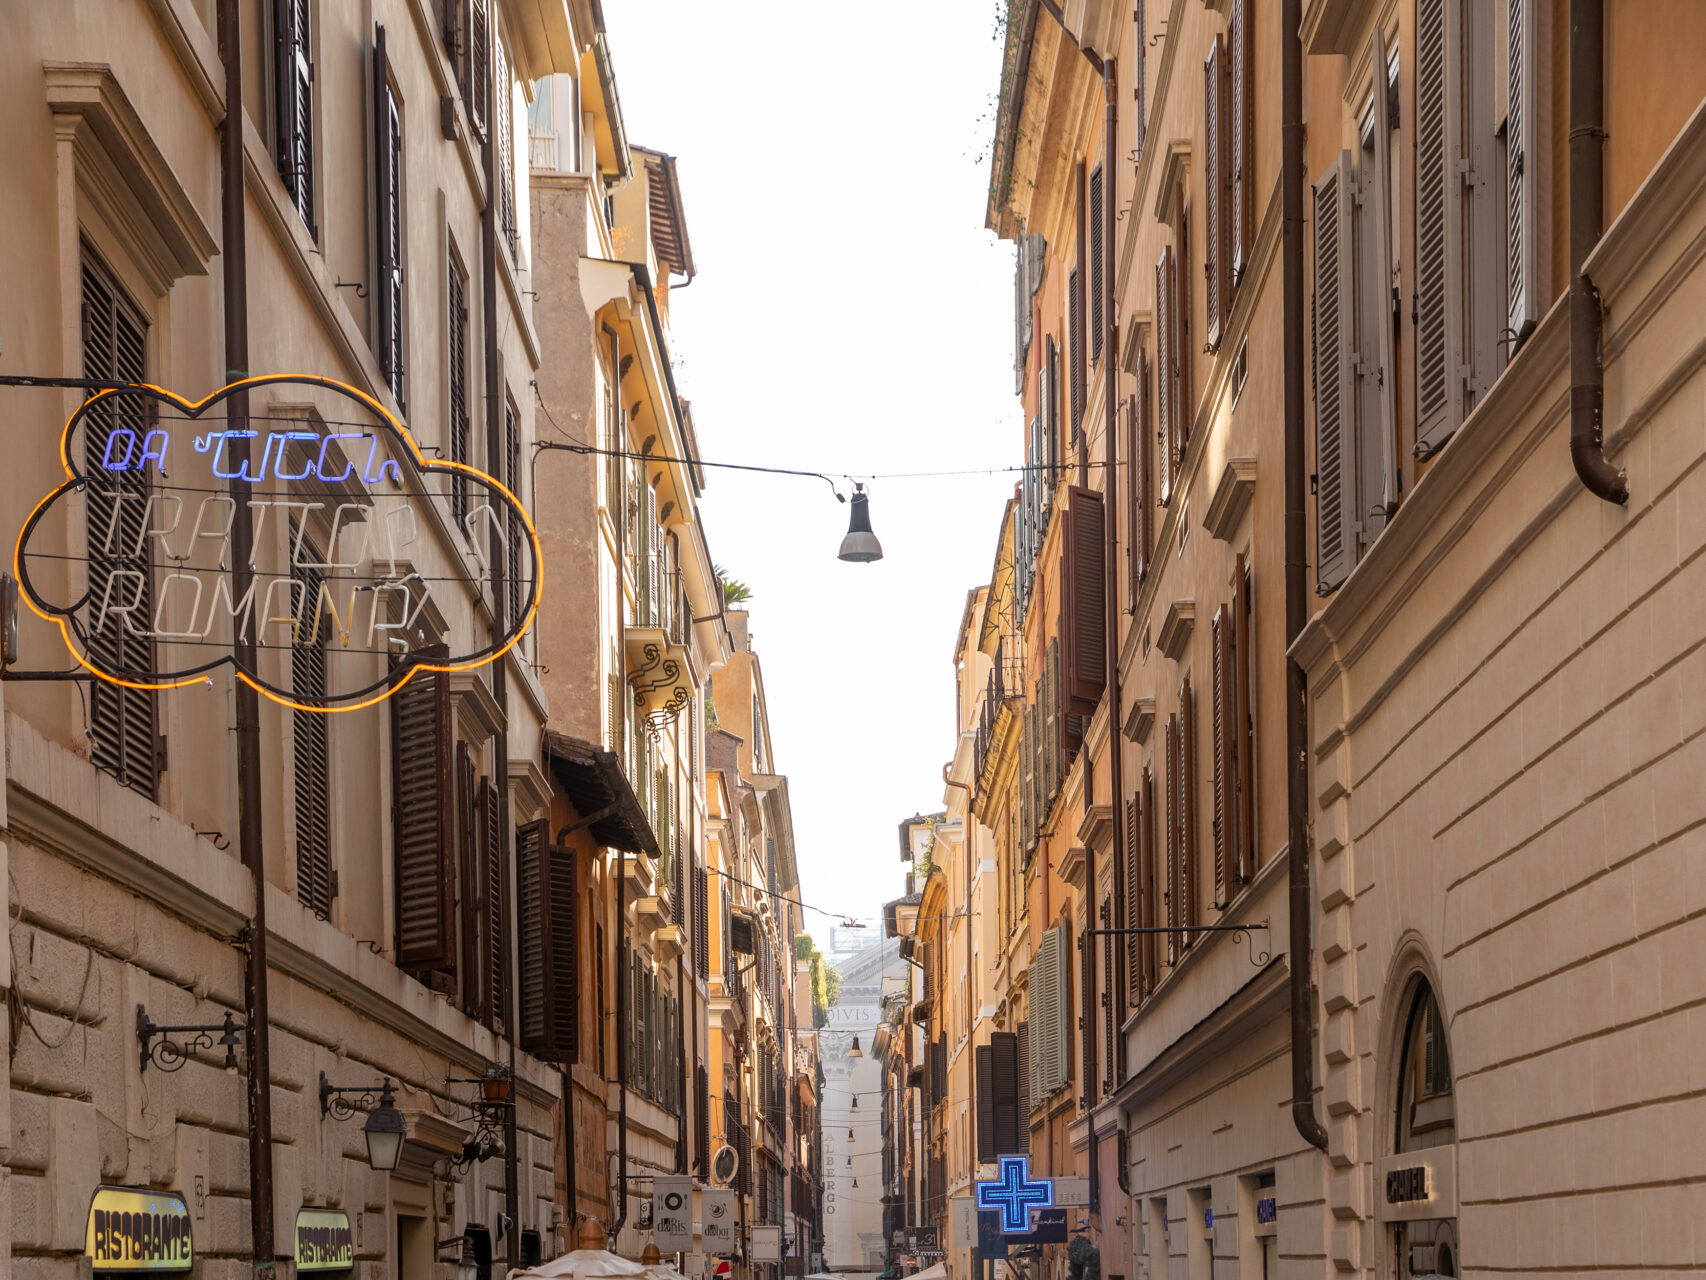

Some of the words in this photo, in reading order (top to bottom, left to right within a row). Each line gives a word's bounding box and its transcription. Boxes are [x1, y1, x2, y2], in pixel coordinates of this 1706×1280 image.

[102, 429, 168, 477] DA
[825, 1132, 836, 1215] ALBERGO
[1386, 1167, 1428, 1204] CHANEL
[94, 1209, 191, 1260] RISTORANTE
[298, 1226, 353, 1263] RISTORANTE
